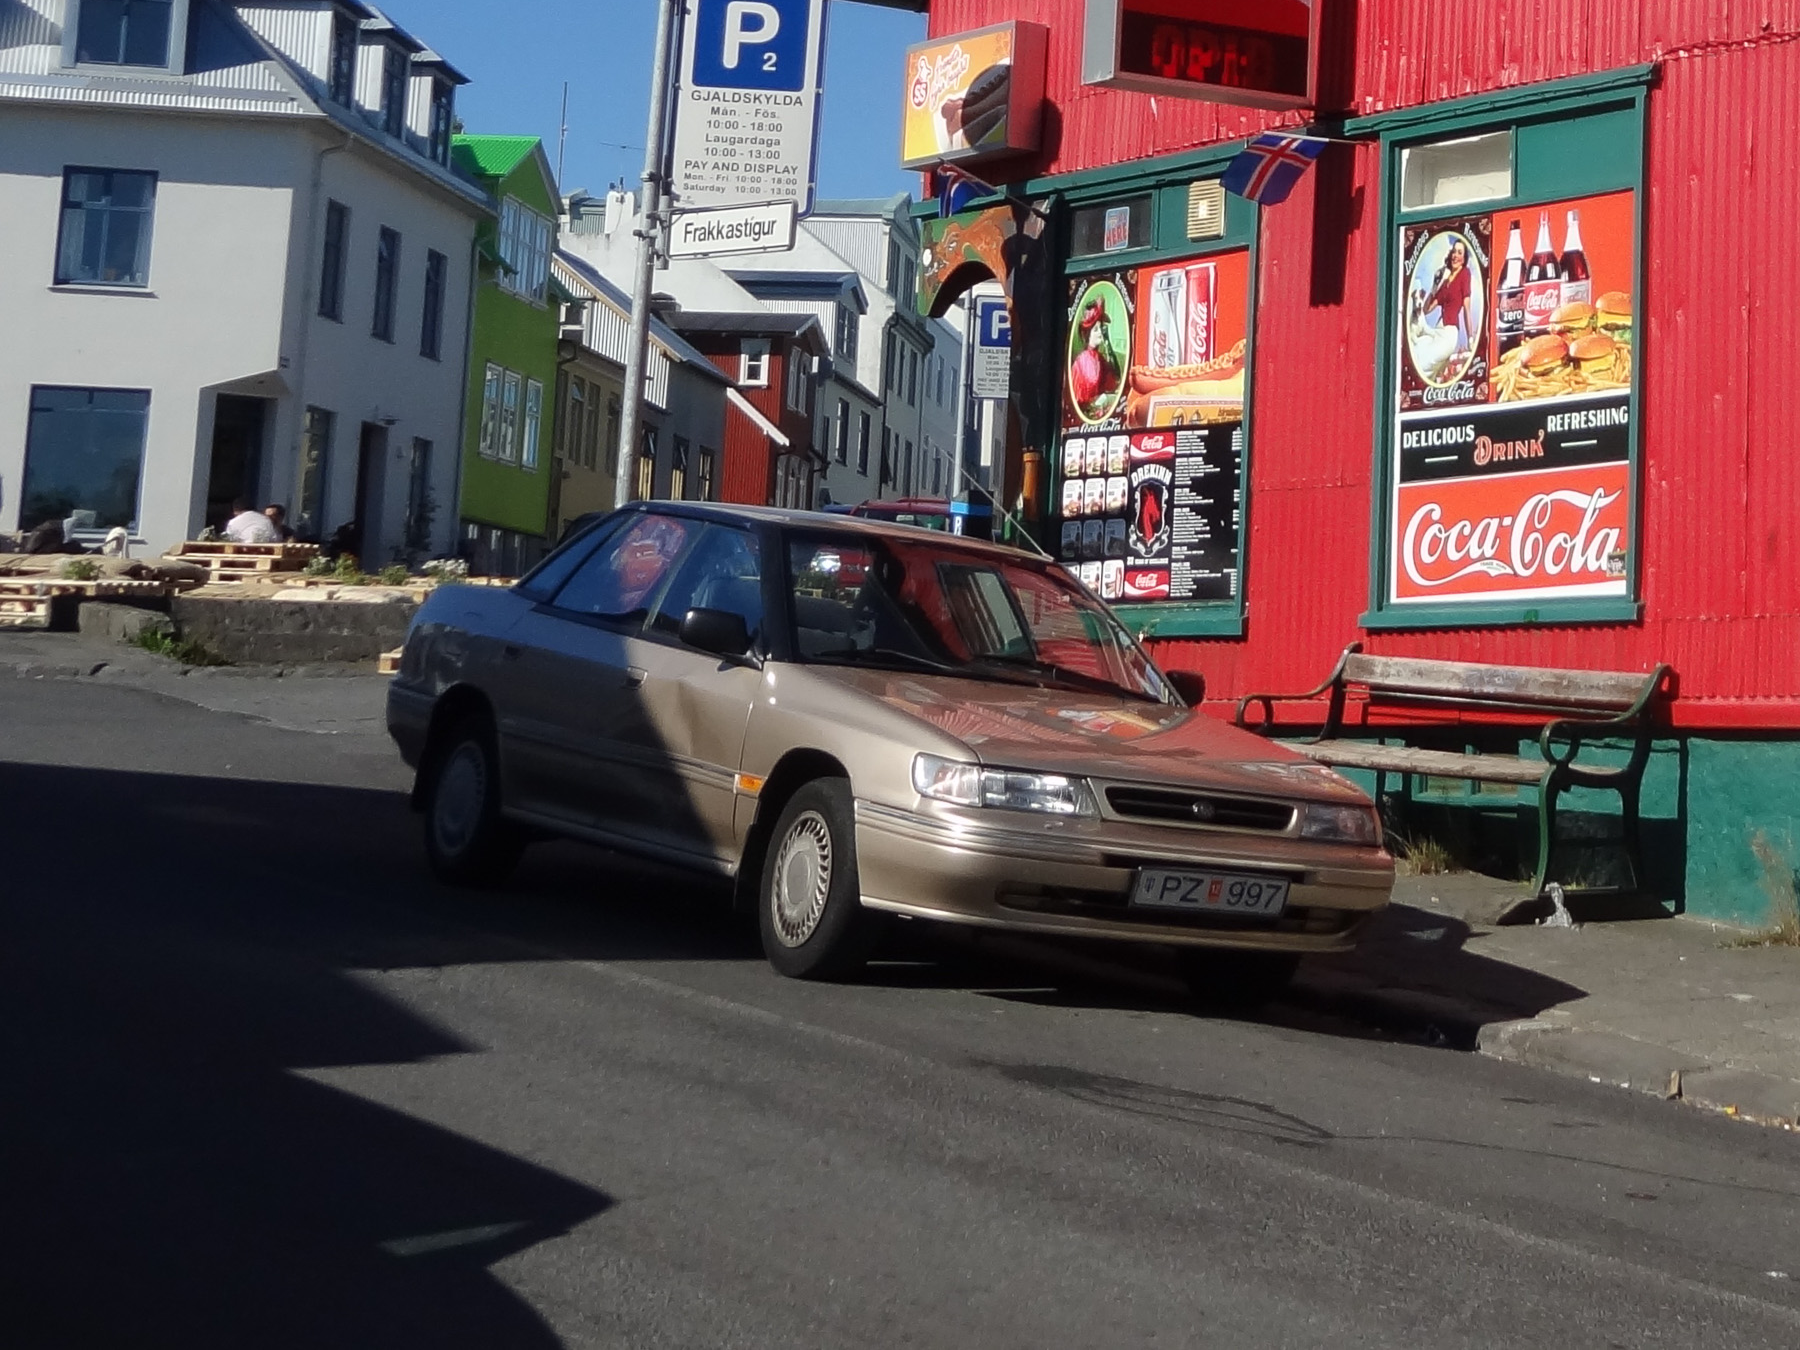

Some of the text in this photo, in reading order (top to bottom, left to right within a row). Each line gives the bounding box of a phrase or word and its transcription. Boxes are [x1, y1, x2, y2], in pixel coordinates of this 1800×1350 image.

[722, 1, 780, 71] P 2
[691, 90, 803, 107] GJALDSKYLDA
[706, 119, 739, 130] 10:00
[750, 122, 783, 133] 18:00
[705, 133, 781, 147] Laugardaga
[704, 147, 737, 157] 10:00
[749, 149, 781, 160] 13:00
[684, 160, 799, 175] PAY AND DISPLAY
[683, 183, 726, 194] Saturday
[735, 185, 761, 194] 10:00
[771, 187, 797, 196] 13:00
[736, 175, 762, 184] 10:00
[771, 177, 798, 186] 18:00
[683, 216, 777, 243] Frakkastígur
[1105, 223, 1127, 248] HERE
[991, 310, 1010, 339] P
[1504, 311, 1522, 321] zero
[1423, 380, 1475, 404] Coca-Cola
[1547, 406, 1628, 432] REFRESHING
[1403, 425, 1475, 448] DELICIOUS
[1403, 487, 1624, 587] Coca-Cola
[1159, 876, 1204, 902] PZ
[1226, 881, 1282, 909] 997
